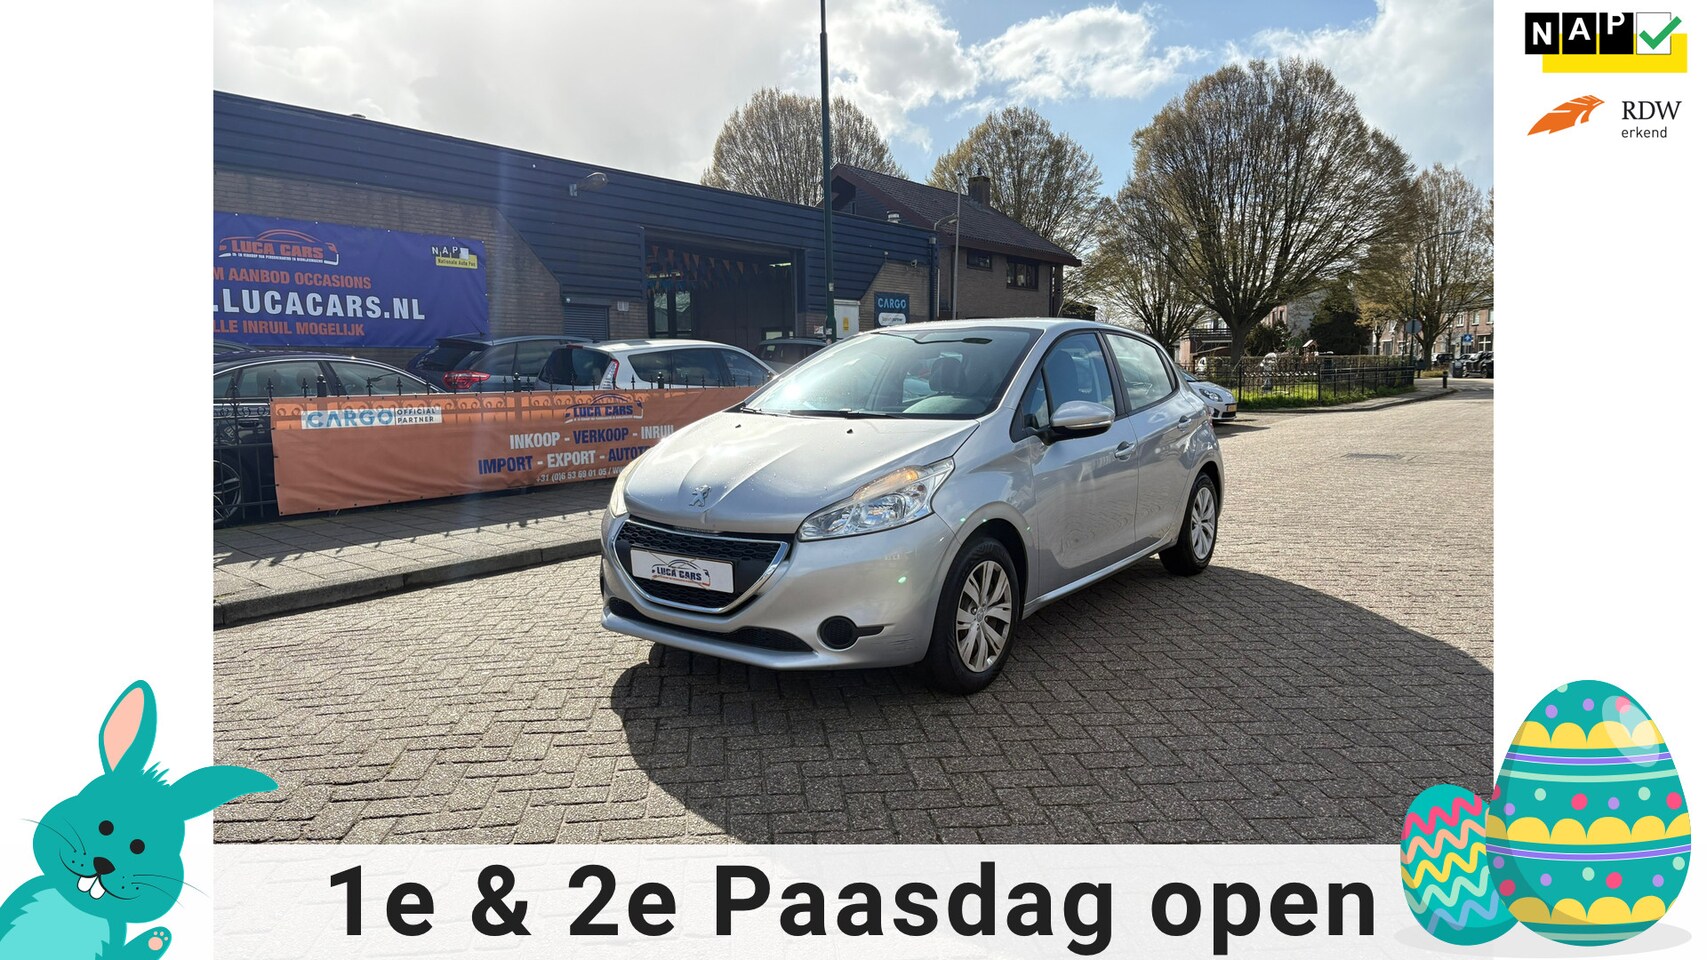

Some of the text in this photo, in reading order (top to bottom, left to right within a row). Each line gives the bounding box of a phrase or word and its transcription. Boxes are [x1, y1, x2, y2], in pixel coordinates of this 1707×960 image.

[231, 239, 275, 255] LUCA
[280, 243, 324, 259] CARS
[431, 246, 458, 255] NAP
[228, 267, 290, 284] AANBOD
[294, 272, 372, 289] OCCASIONS
[877, 297, 907, 309] CARGO
[242, 320, 292, 335] INRUIL
[295, 321, 365, 336] MOGELIJK
[306, 409, 394, 428] CARGO
[573, 405, 633, 417] LUCA CARS
[397, 416, 434, 424] PARTNER
[509, 432, 561, 450] INKOOP
[572, 427, 629, 444] VERKOOP
[478, 455, 533, 475] IMPORT
[547, 450, 596, 468] EXPORT
[551, 472, 566, 482] (0)6
[567, 471, 576, 479] 53
[588, 469, 596, 477] 01
[656, 566, 677, 577] LUCA
[679, 570, 702, 581] CARS
